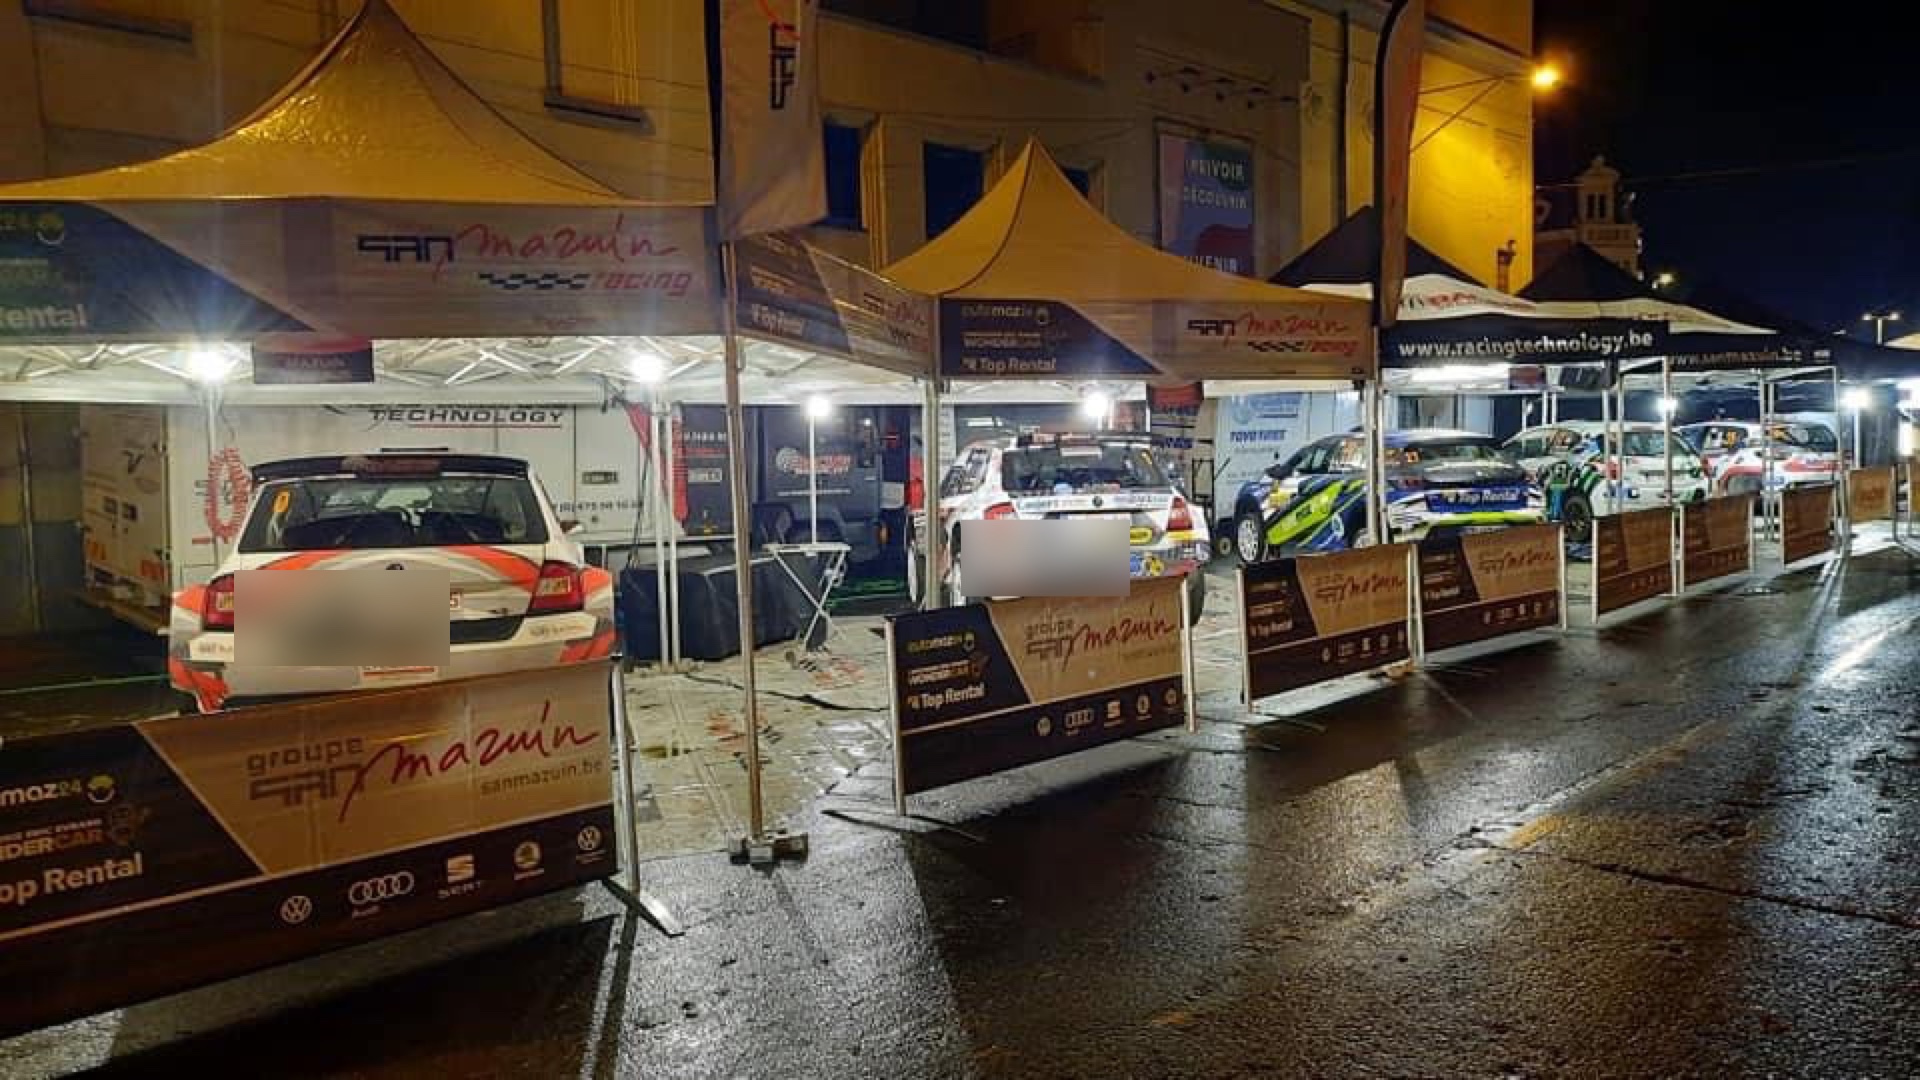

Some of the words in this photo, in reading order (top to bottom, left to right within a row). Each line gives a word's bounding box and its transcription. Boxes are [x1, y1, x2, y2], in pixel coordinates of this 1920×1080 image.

[594, 270, 692, 297] racing
[1399, 329, 1653, 359] www.racingtechnology.be
[1008, 356, 1056, 371] Rental
[369, 408, 565, 425] TECHNOLOGY
[945, 682, 985, 705] Rental
[247, 736, 364, 776] groupe
[43, 851, 143, 894] Rental
